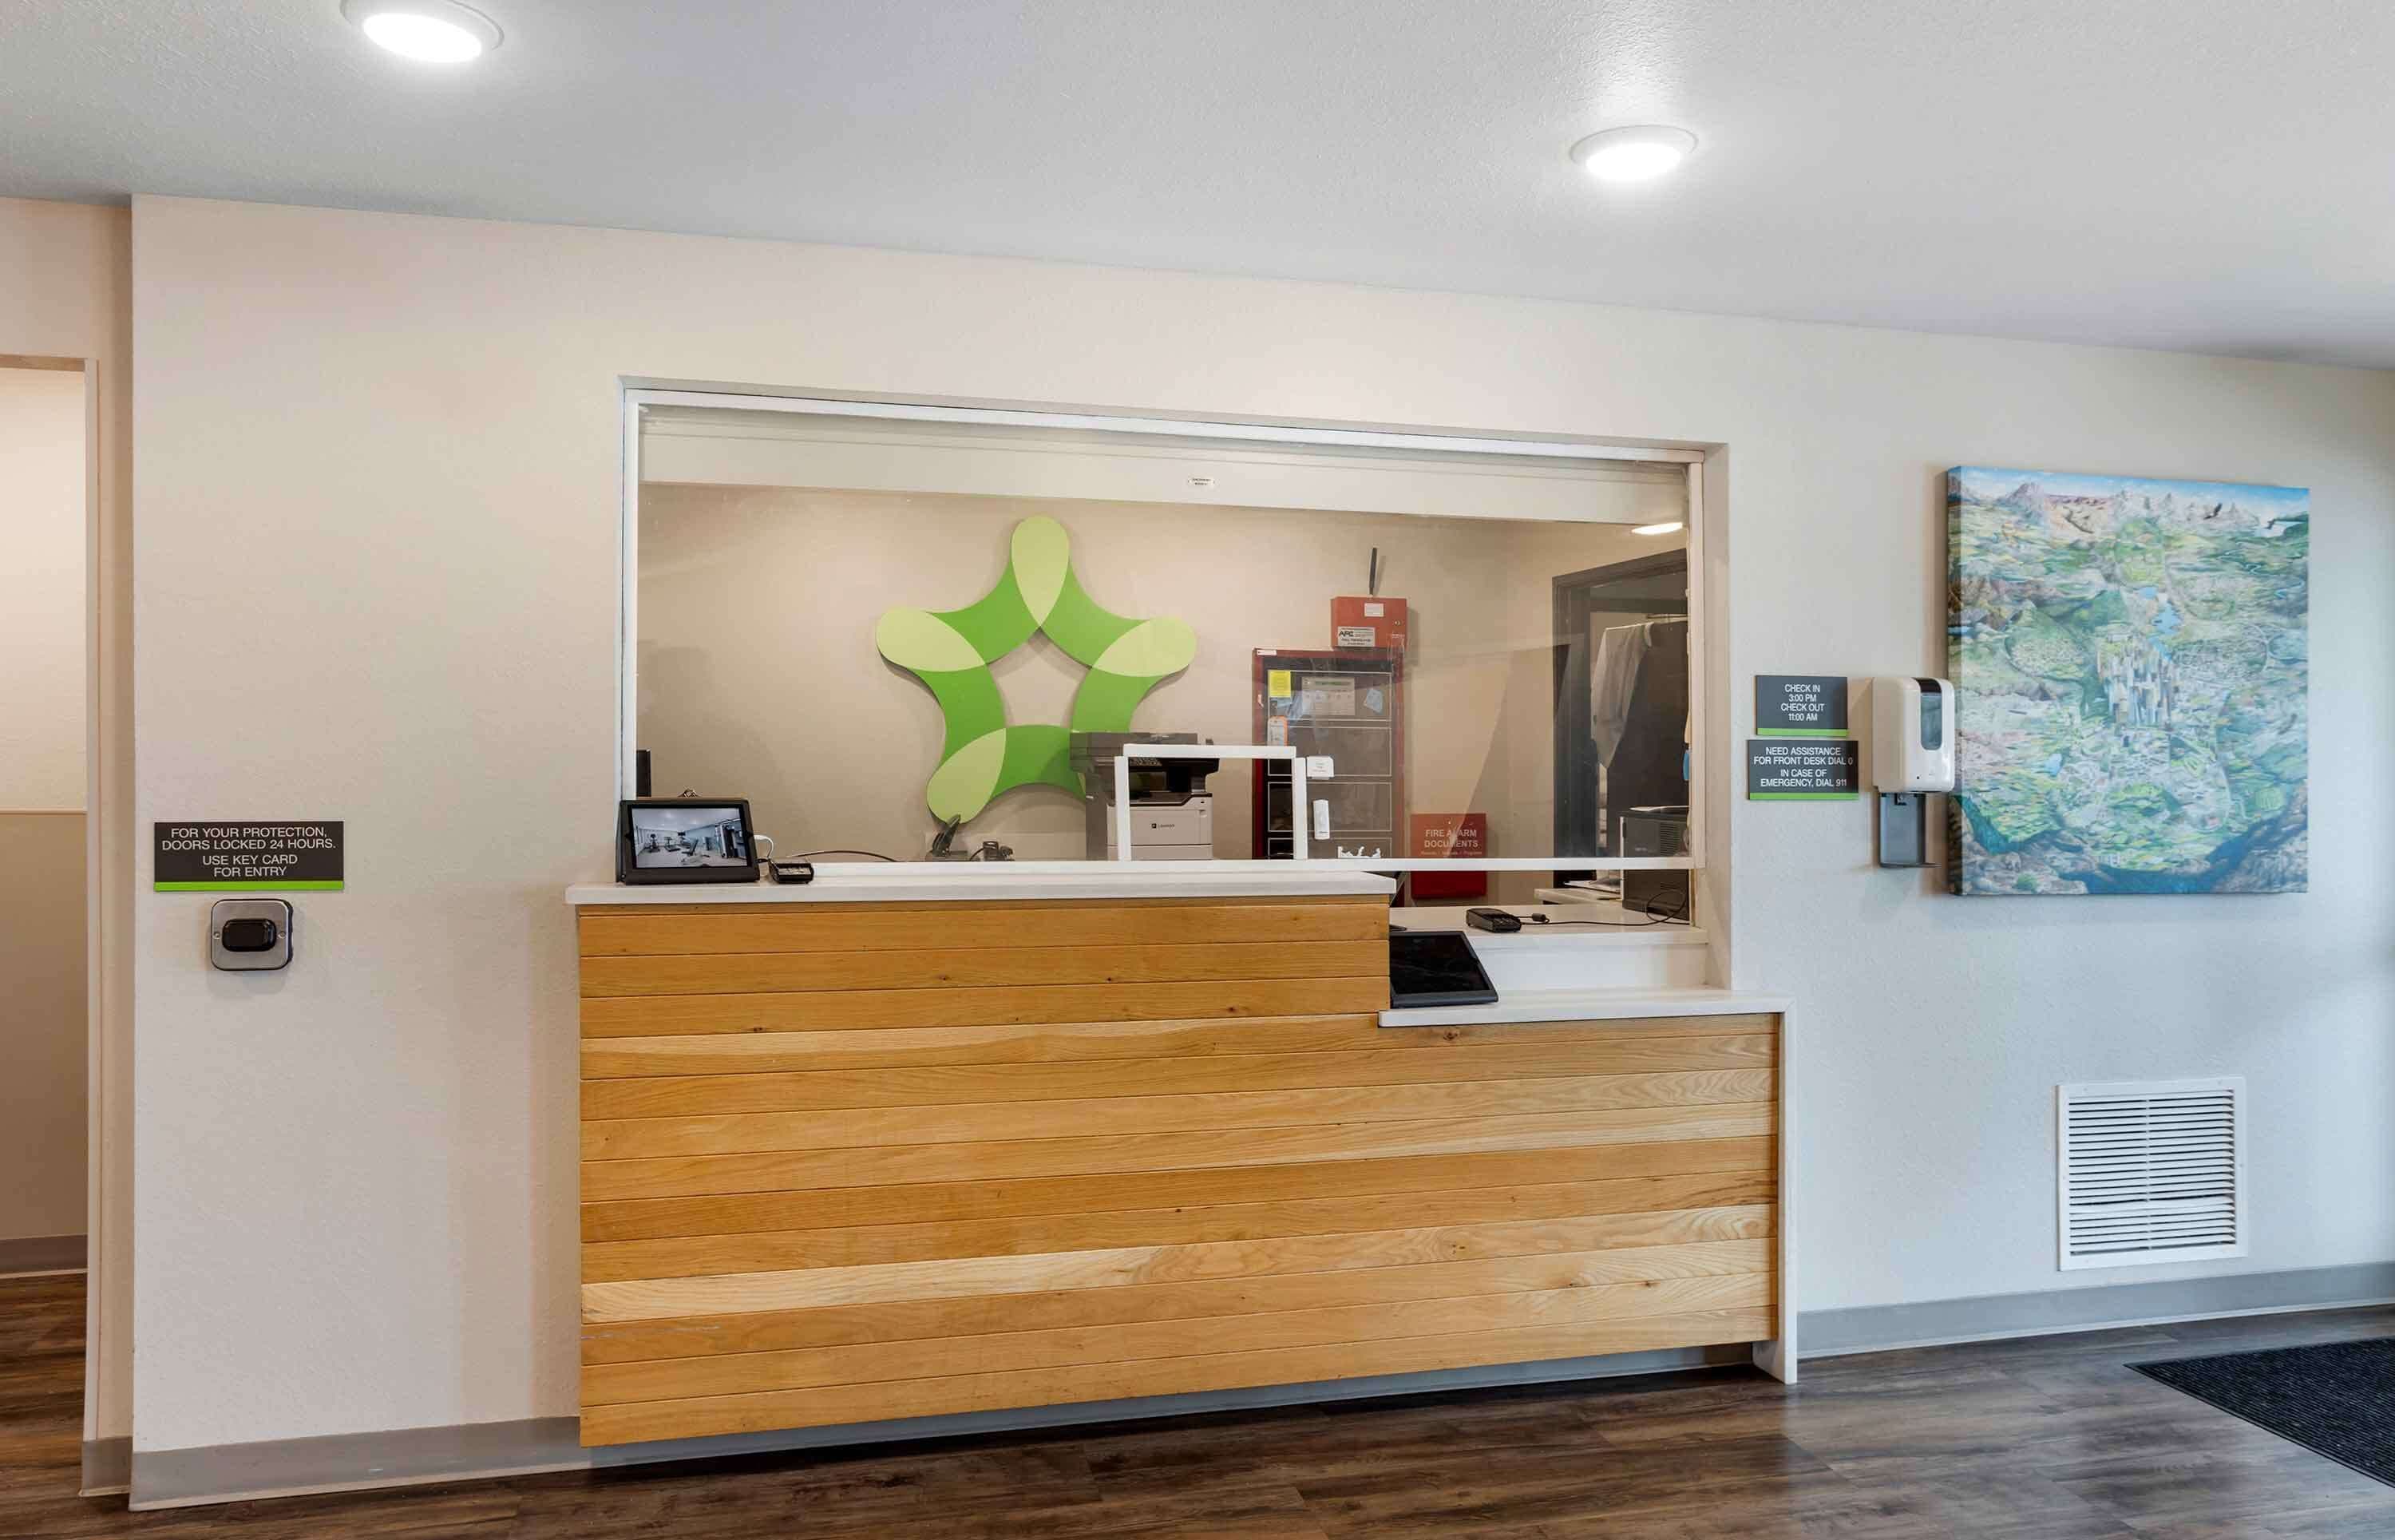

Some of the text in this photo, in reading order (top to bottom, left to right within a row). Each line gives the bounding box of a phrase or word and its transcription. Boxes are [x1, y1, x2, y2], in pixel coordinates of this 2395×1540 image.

[1754, 756, 1772, 765] FOR
[1760, 778, 1814, 787] EMERGENCY,
[171, 826, 327, 838] FOR YOUR PROTECTION,
[162, 838, 336, 850] DOORS LOCKED 24 HOURS.
[203, 854, 298, 865] USE KEY CARD
[214, 866, 287, 877] FOR ENTRY
